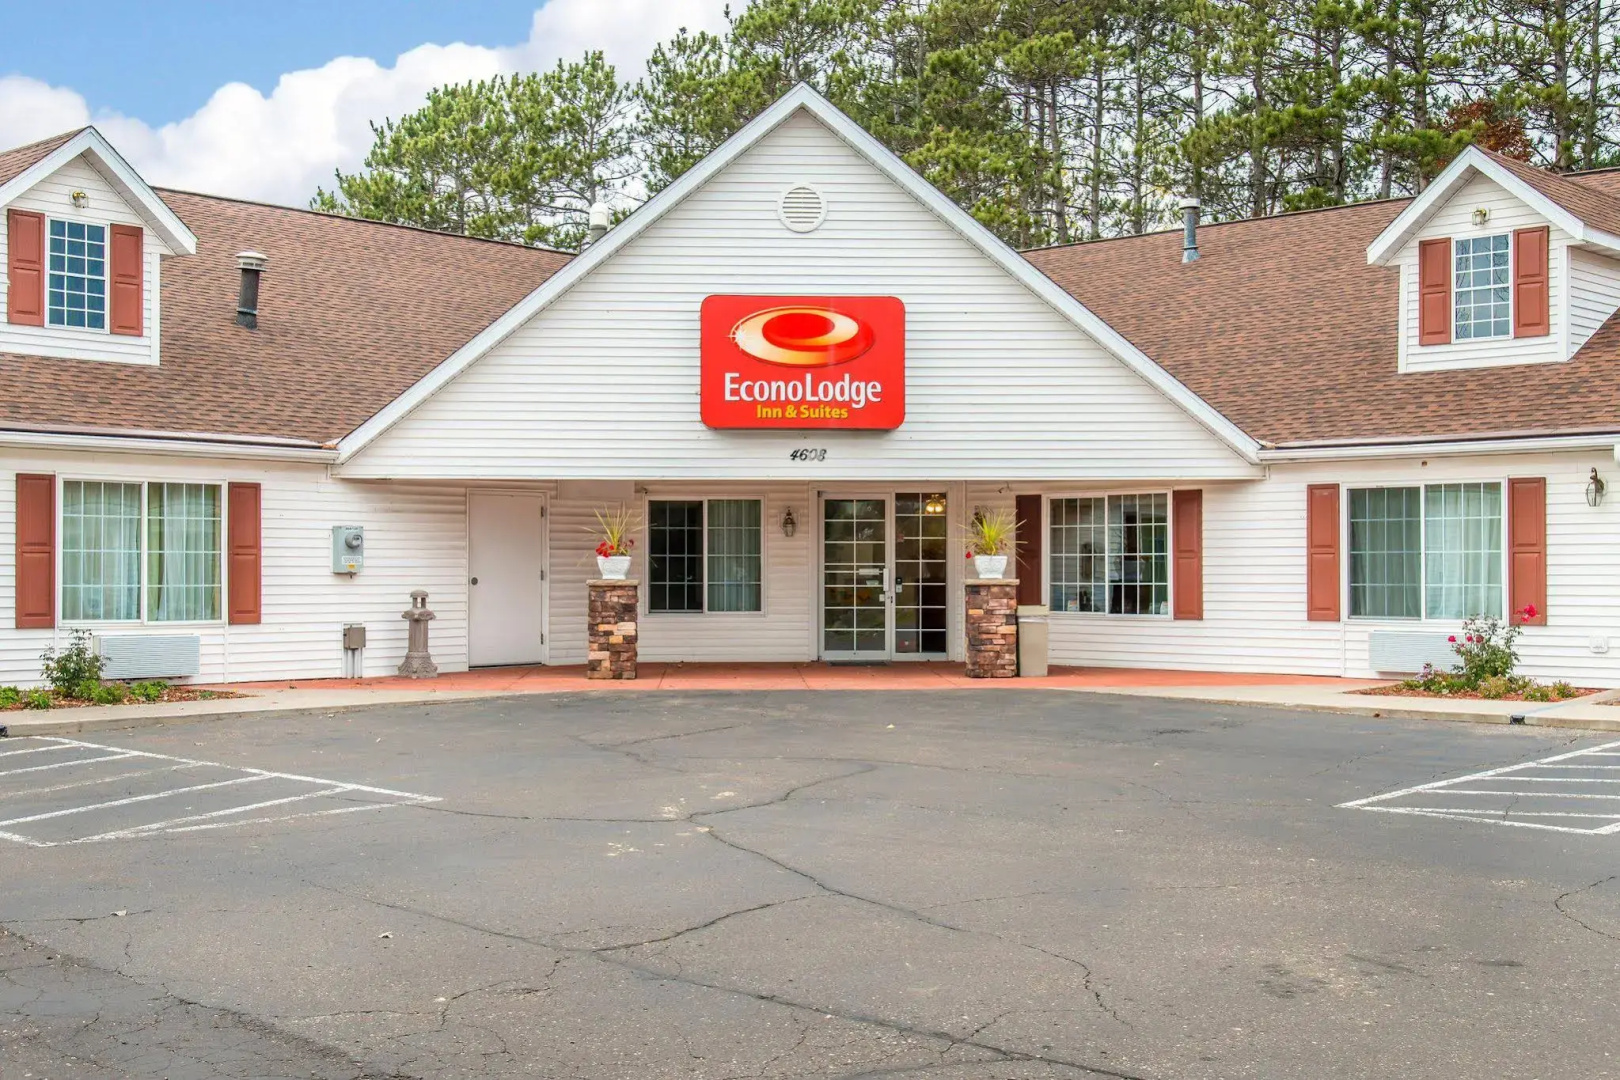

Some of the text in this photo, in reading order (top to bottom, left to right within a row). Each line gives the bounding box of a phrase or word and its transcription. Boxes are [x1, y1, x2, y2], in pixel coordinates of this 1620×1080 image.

[757, 404, 848, 418] Inn & Suites
[790, 448, 827, 461] 4608
